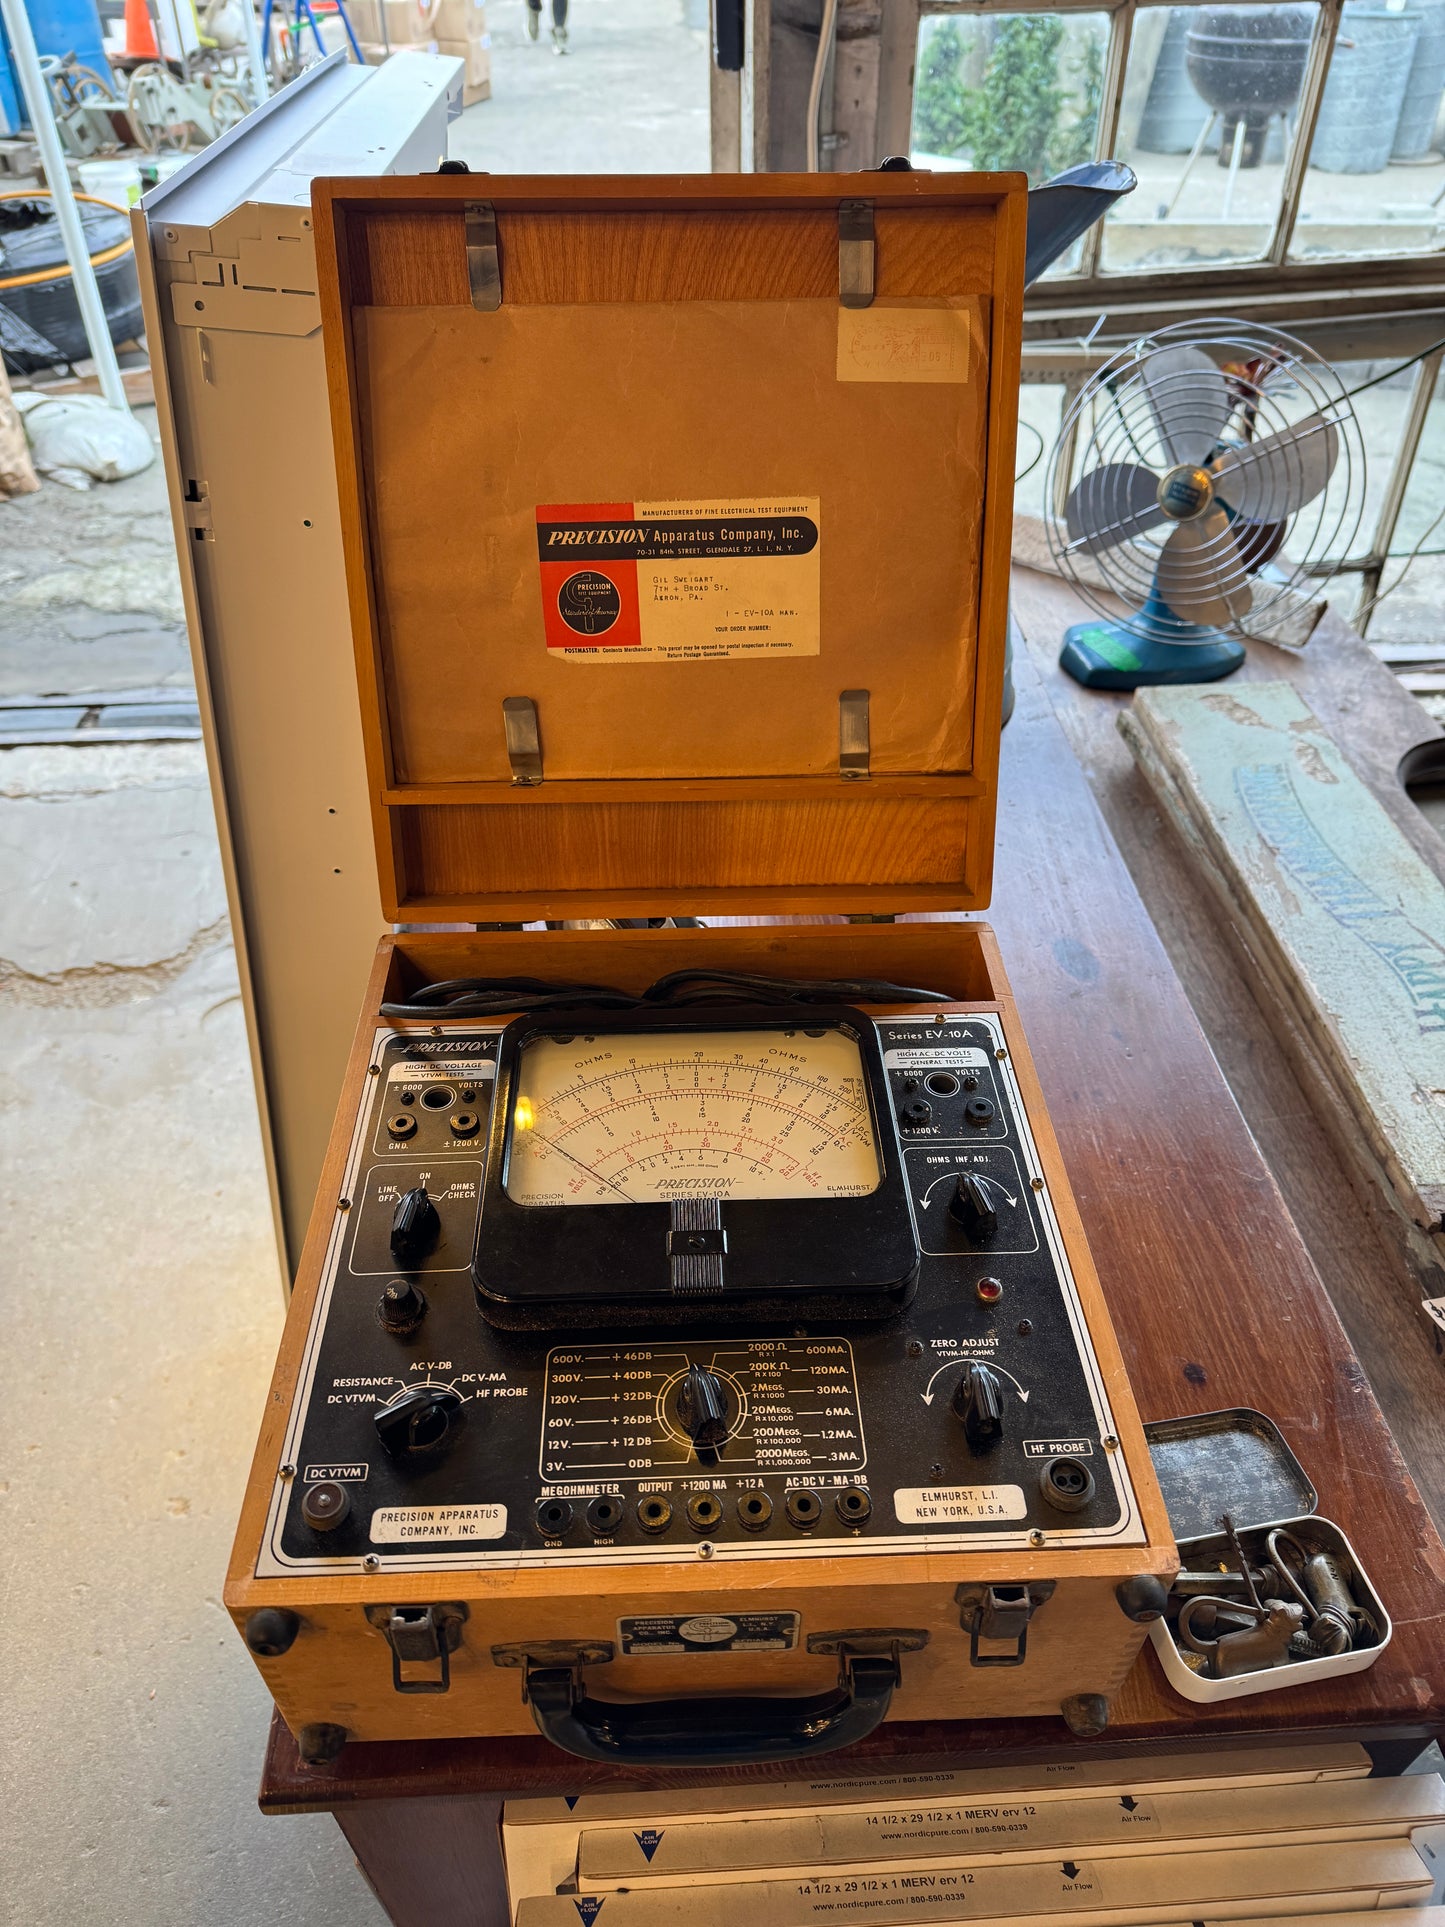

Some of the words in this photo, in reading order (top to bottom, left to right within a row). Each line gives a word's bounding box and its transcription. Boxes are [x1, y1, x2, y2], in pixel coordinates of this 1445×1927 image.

[547, 528, 652, 546] PRECISION
[654, 528, 714, 543] Apparatus
[721, 528, 776, 542] Company,
[782, 527, 804, 539] Inc.
[684, 584, 709, 592] BROAD
[889, 1032, 922, 1040] Series
[925, 1030, 973, 1038] EV-10A
[401, 1041, 494, 1053] PRECISION
[574, 1052, 613, 1069] OHMS
[768, 1048, 808, 1063] OHMS
[817, 1075, 829, 1083] 100
[655, 1178, 736, 1189] PRECISION
[378, 1186, 398, 1194] LINE
[448, 1191, 476, 1199] CHECK
[378, 1194, 395, 1202] OFF
[748, 1343, 774, 1351] 2000
[930, 1339, 957, 1348] ZERO
[962, 1338, 999, 1346] ADJUST
[410, 1362, 427, 1370] AC
[428, 1361, 452, 1370] V-DB
[333, 1377, 394, 1387] RESISTANCE
[461, 1374, 476, 1382] DC
[477, 1373, 507, 1381] V-MA
[476, 1389, 490, 1398] HF
[493, 1388, 528, 1397] PROBE
[328, 1395, 343, 1404] DC
[345, 1394, 376, 1403] VTVM
[1031, 1444, 1045, 1454] HF
[1049, 1443, 1085, 1452] PROBE
[310, 1469, 327, 1478] DC
[328, 1469, 361, 1477] VTVM
[638, 1482, 673, 1493] OUTPUT
[713, 1480, 727, 1489] MA
[541, 1484, 619, 1496] MEGOHMMETER
[922, 1491, 978, 1502] ELMHURST,
[982, 1490, 998, 1499] L.I.
[380, 1512, 434, 1522] PRECISION
[440, 1510, 499, 1520] APPARATUS
[916, 1508, 937, 1517] NEW
[943, 1506, 972, 1516] YORK,
[978, 1505, 1008, 1514] U.S.A.
[400, 1527, 453, 1536] COMPANY,
[458, 1525, 478, 1534] INC.
[810, 1778, 897, 1790] www.nordicpure.com
[902, 1774, 954, 1784] 800-590-0339
[865, 1816, 878, 1826] 14
[882, 1815, 898, 1825] 1/2
[910, 1813, 923, 1823] 29
[927, 1812, 943, 1822] 1/2
[965, 1809, 999, 1819] MERV
[1002, 1808, 1019, 1817] erv
[1023, 1806, 1036, 1816] 12
[1121, 1815, 1132, 1823] Air
[1134, 1814, 1151, 1823] Flow
[881, 1828, 970, 1841] www.nordicpure.com
[975, 1824, 1028, 1834] 800-590-0339
[798, 1886, 811, 1896] 14
[814, 1884, 831, 1894] 1/2
[844, 1882, 858, 1892] 29
[861, 1880, 879, 1891] 1/2
[901, 1877, 936, 1888] MERV
[939, 1876, 957, 1886] erv
[961, 1874, 975, 1884] 12
[1062, 1883, 1074, 1891] Air
[1076, 1882, 1093, 1891] Flow
[813, 1897, 904, 1912] www.nordicpure.com
[910, 1892, 965, 1904] 800-590-0339
